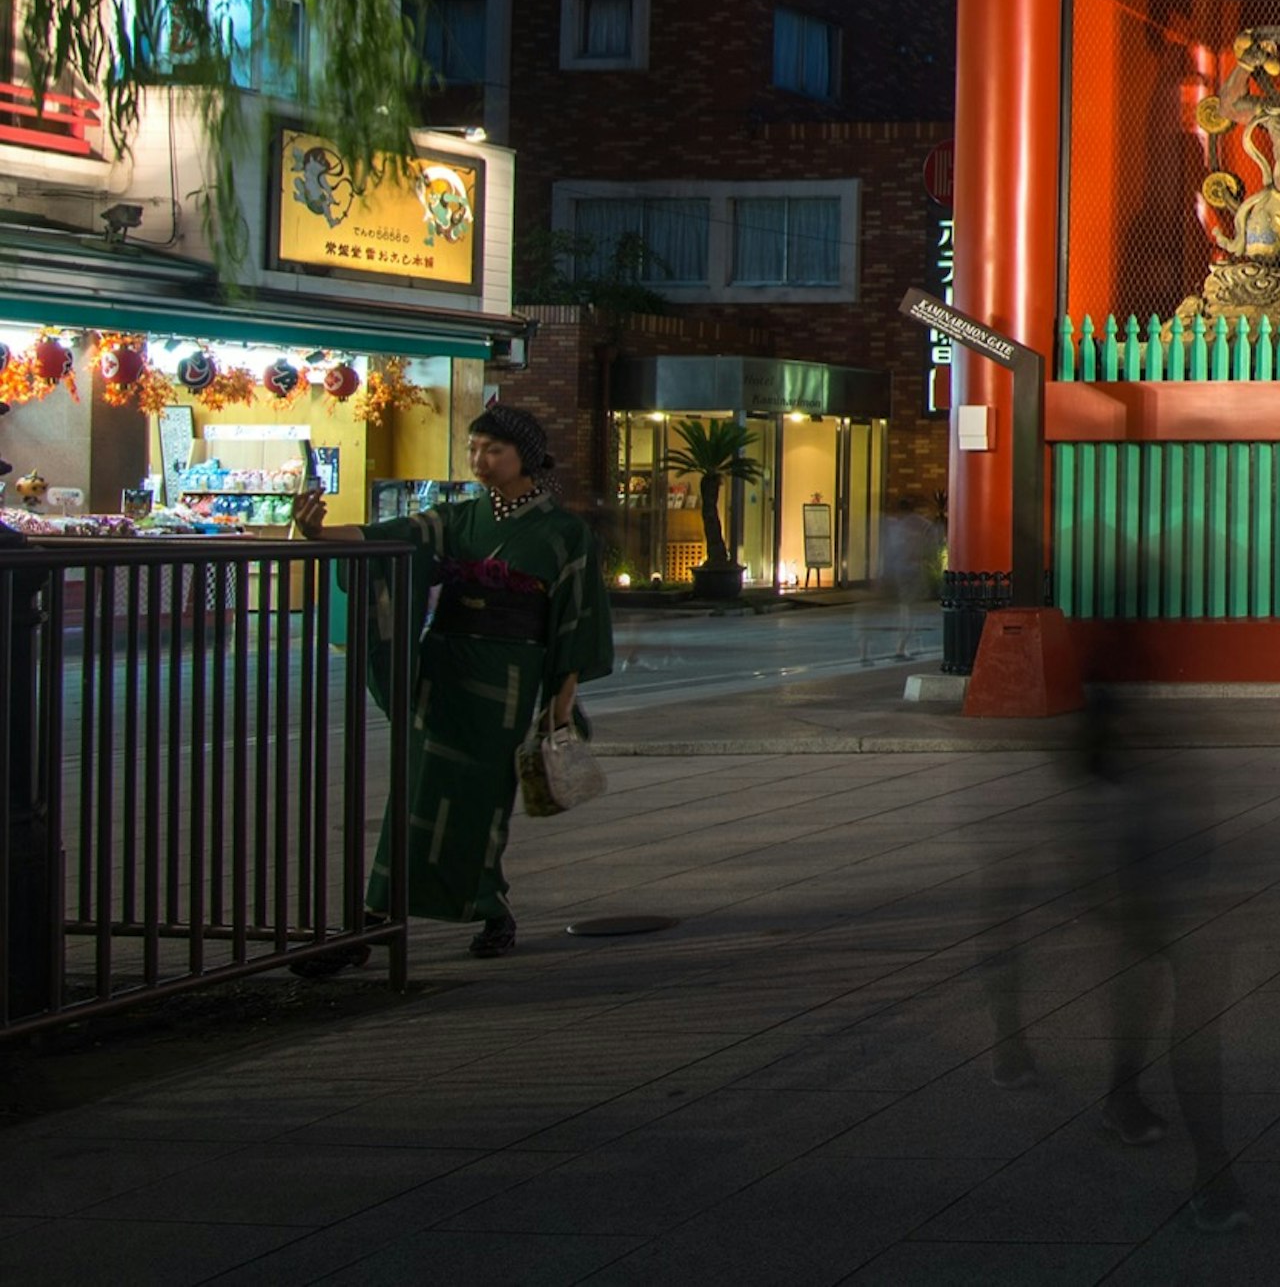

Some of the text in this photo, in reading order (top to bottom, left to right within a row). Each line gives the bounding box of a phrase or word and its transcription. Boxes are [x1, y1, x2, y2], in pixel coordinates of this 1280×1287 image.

[917, 298, 990, 344] KAMINARIMON
[986, 335, 1015, 357] GATE
[743, 373, 774, 388] Hotel
